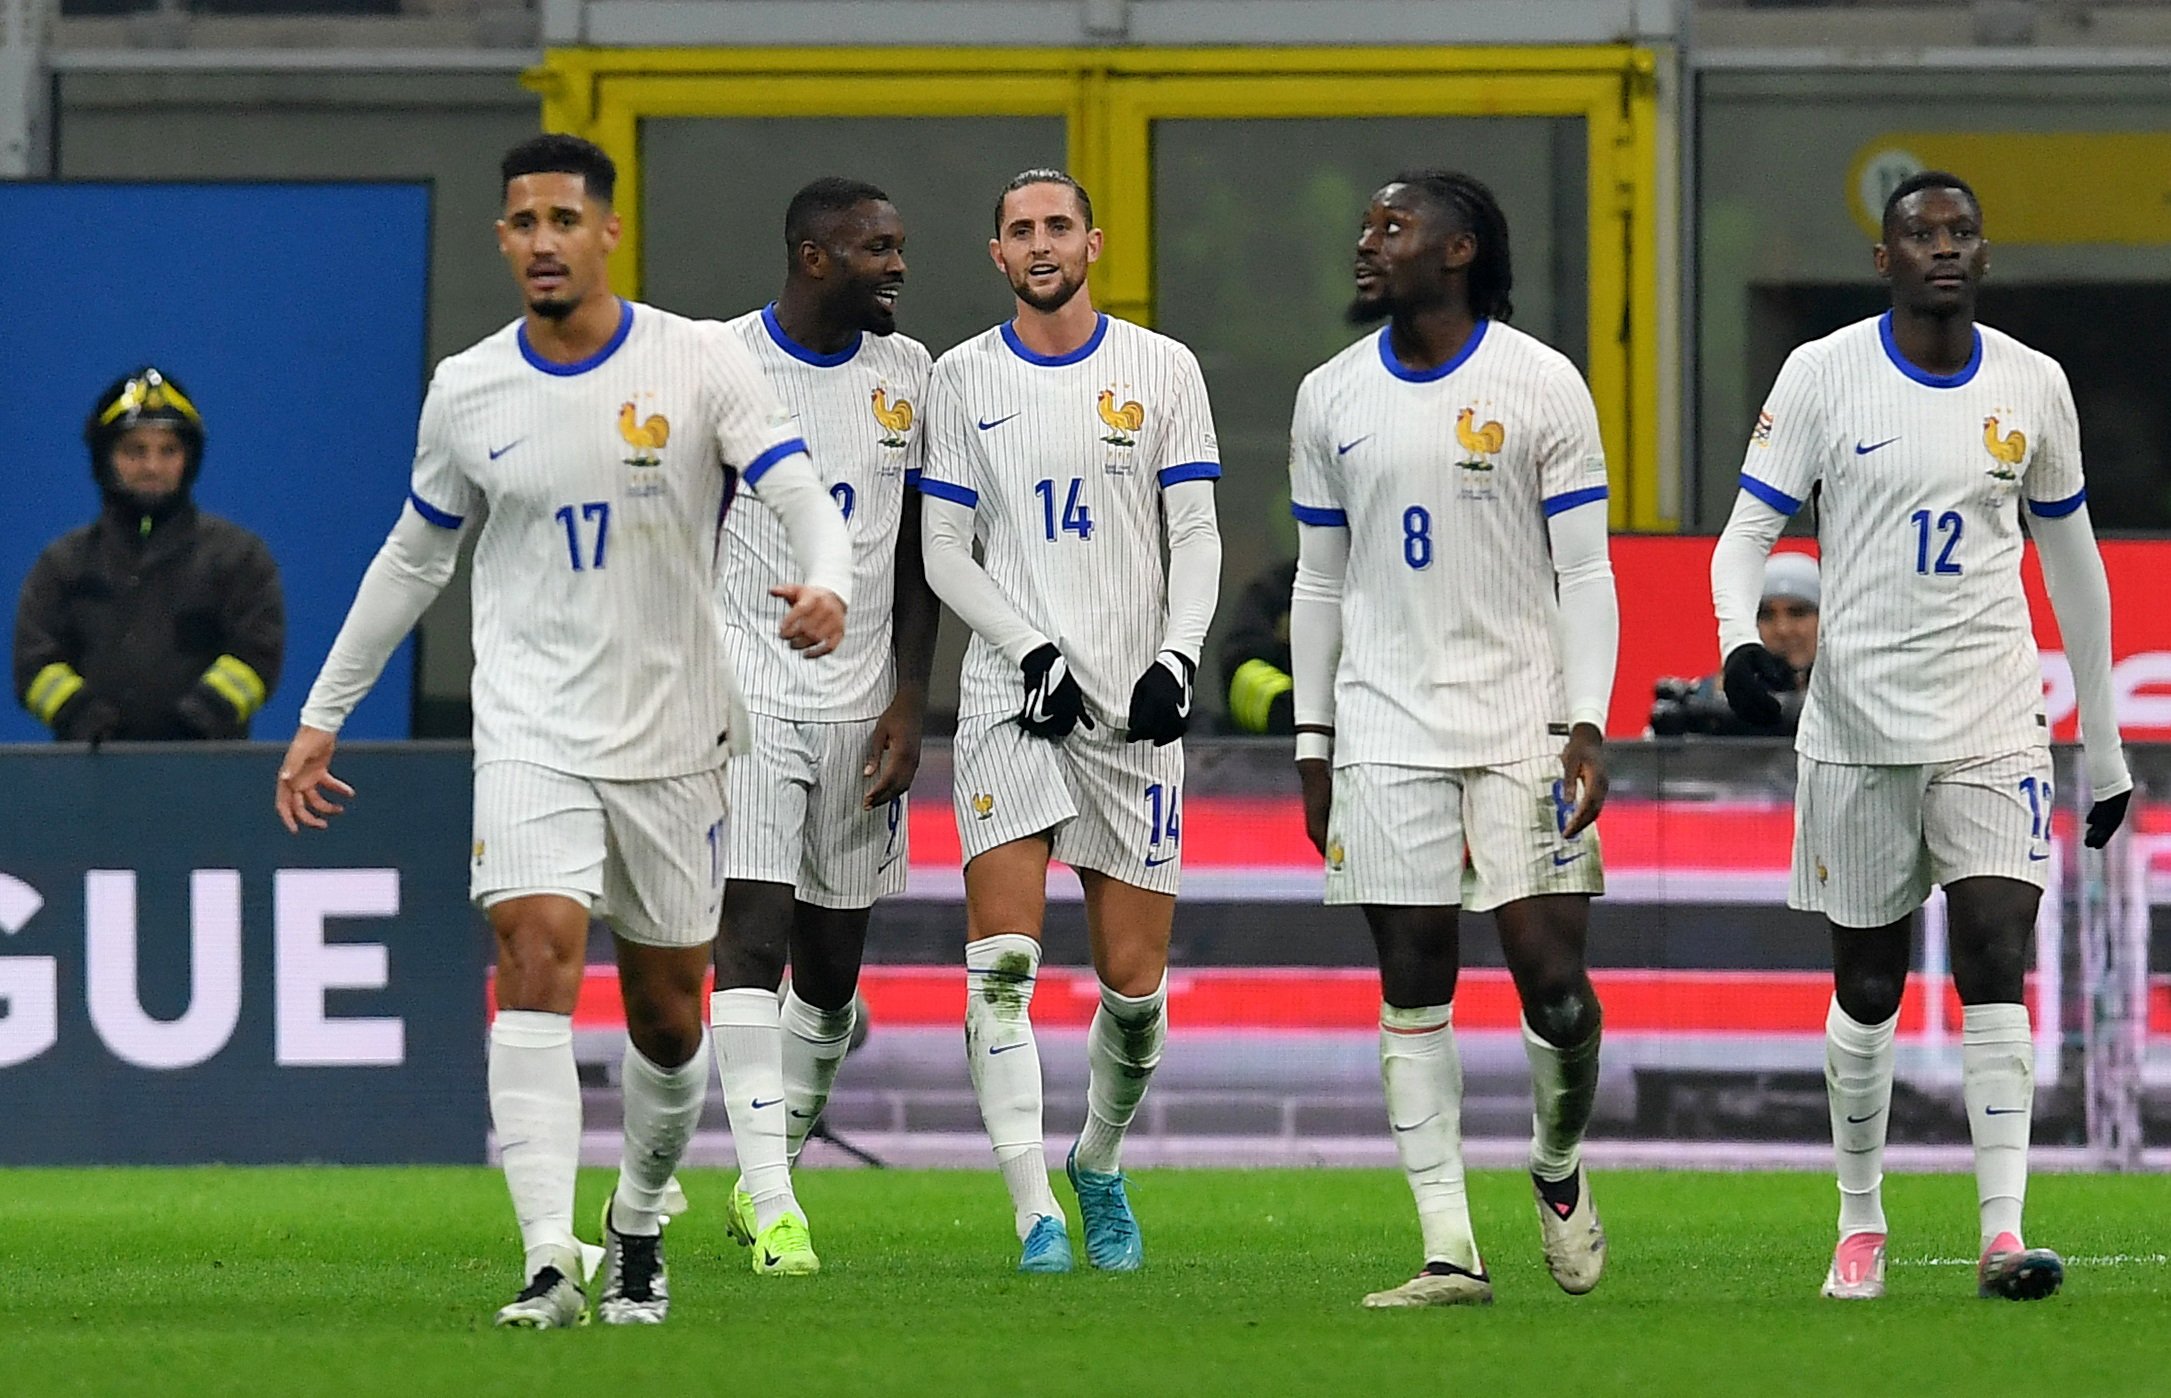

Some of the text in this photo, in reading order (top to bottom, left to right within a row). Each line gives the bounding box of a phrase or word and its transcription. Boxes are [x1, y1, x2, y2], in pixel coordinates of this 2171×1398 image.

[555, 502, 609, 572] 17
[1035, 477, 1094, 542] 14
[1403, 505, 1433, 571] 8
[1911, 509, 1964, 576] 12
[1144, 783, 1179, 849] 14
